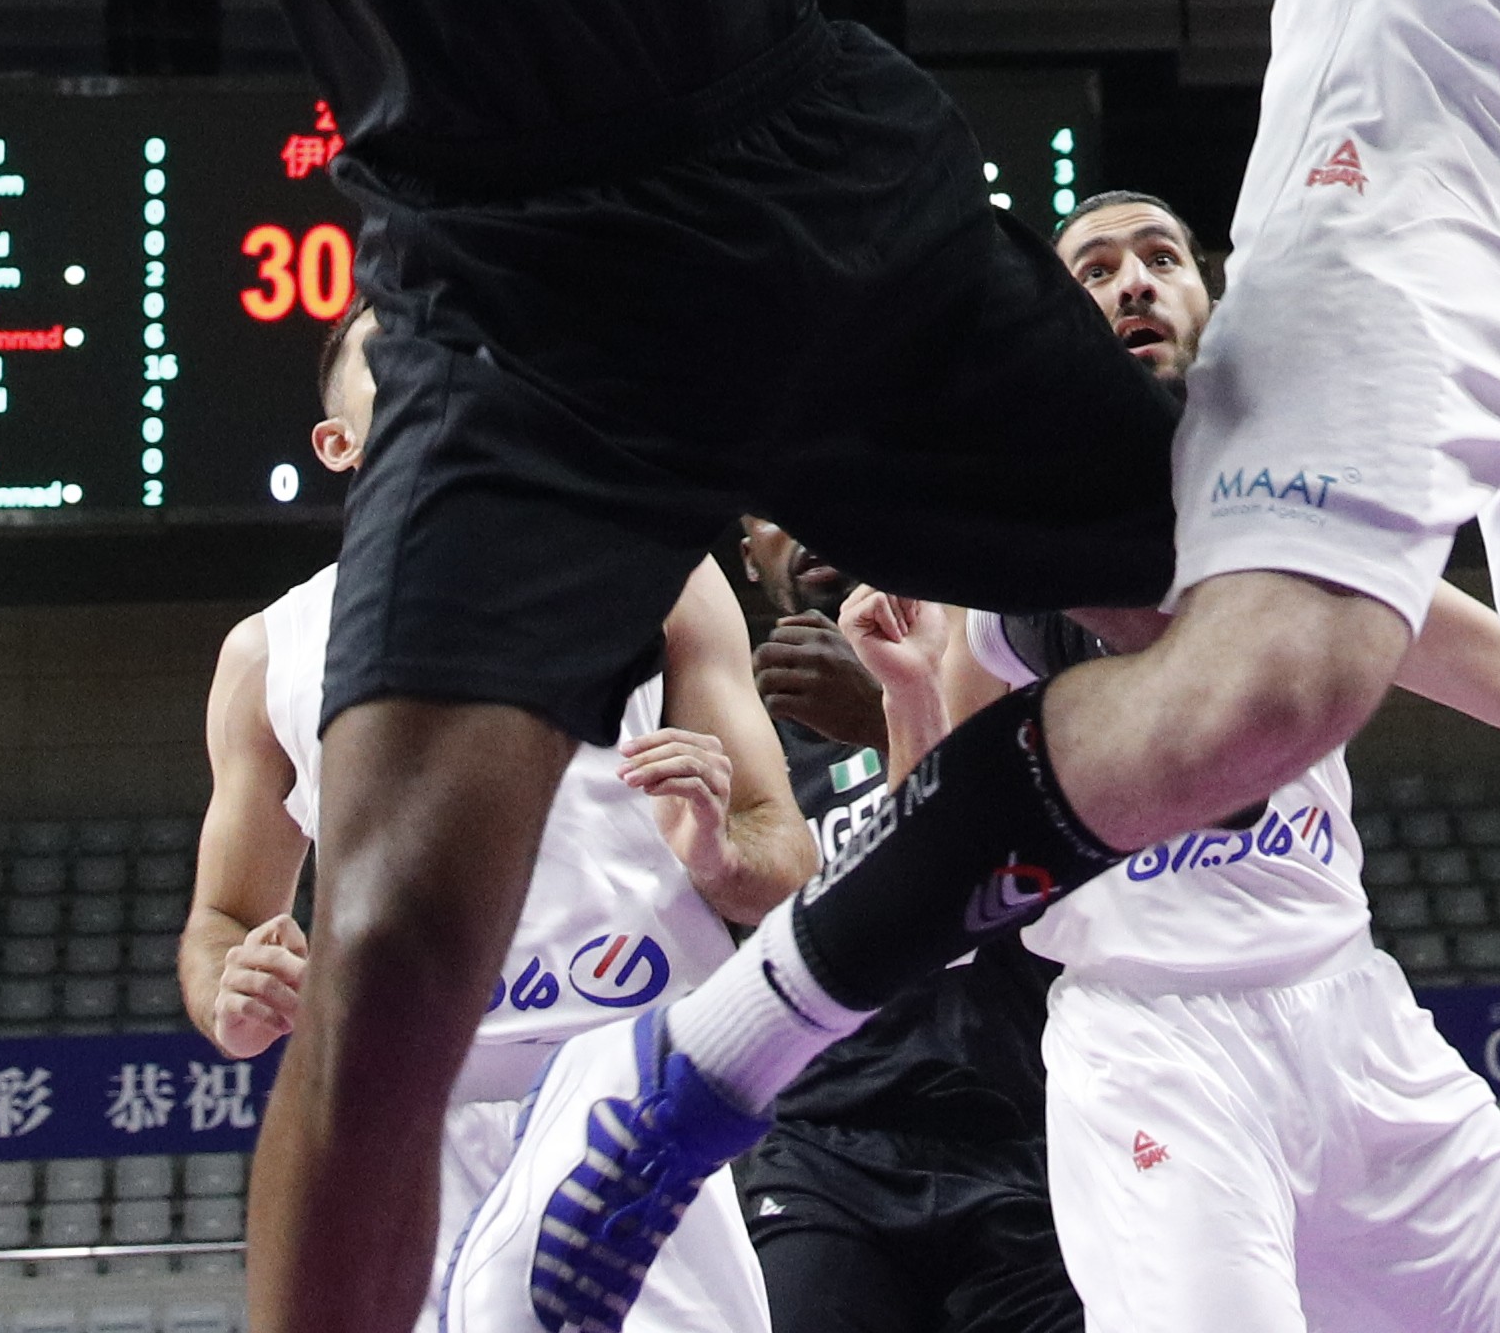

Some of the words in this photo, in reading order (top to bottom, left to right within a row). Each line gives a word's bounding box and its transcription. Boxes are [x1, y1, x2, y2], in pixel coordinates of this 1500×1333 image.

[144, 138, 166, 164] 0
[281, 134, 345, 179] 伊
[144, 169, 165, 195] 0
[144, 199, 165, 225] 0
[144, 230, 165, 256] 0
[145, 261, 165, 286] 2
[240, 224, 355, 320] 30
[143, 292, 165, 318] 0
[144, 323, 165, 349] 6
[144, 354, 178, 380] 16
[141, 385, 163, 411] 4
[142, 417, 163, 443] 0
[142, 448, 163, 474] 0
[142, 480, 163, 506] 2
[271, 464, 299, 502] 0
[1211, 467, 1338, 509] MAAT
[107, 1060, 272, 1134] 恭祝
[1133, 1145, 1171, 1173] PEAK
